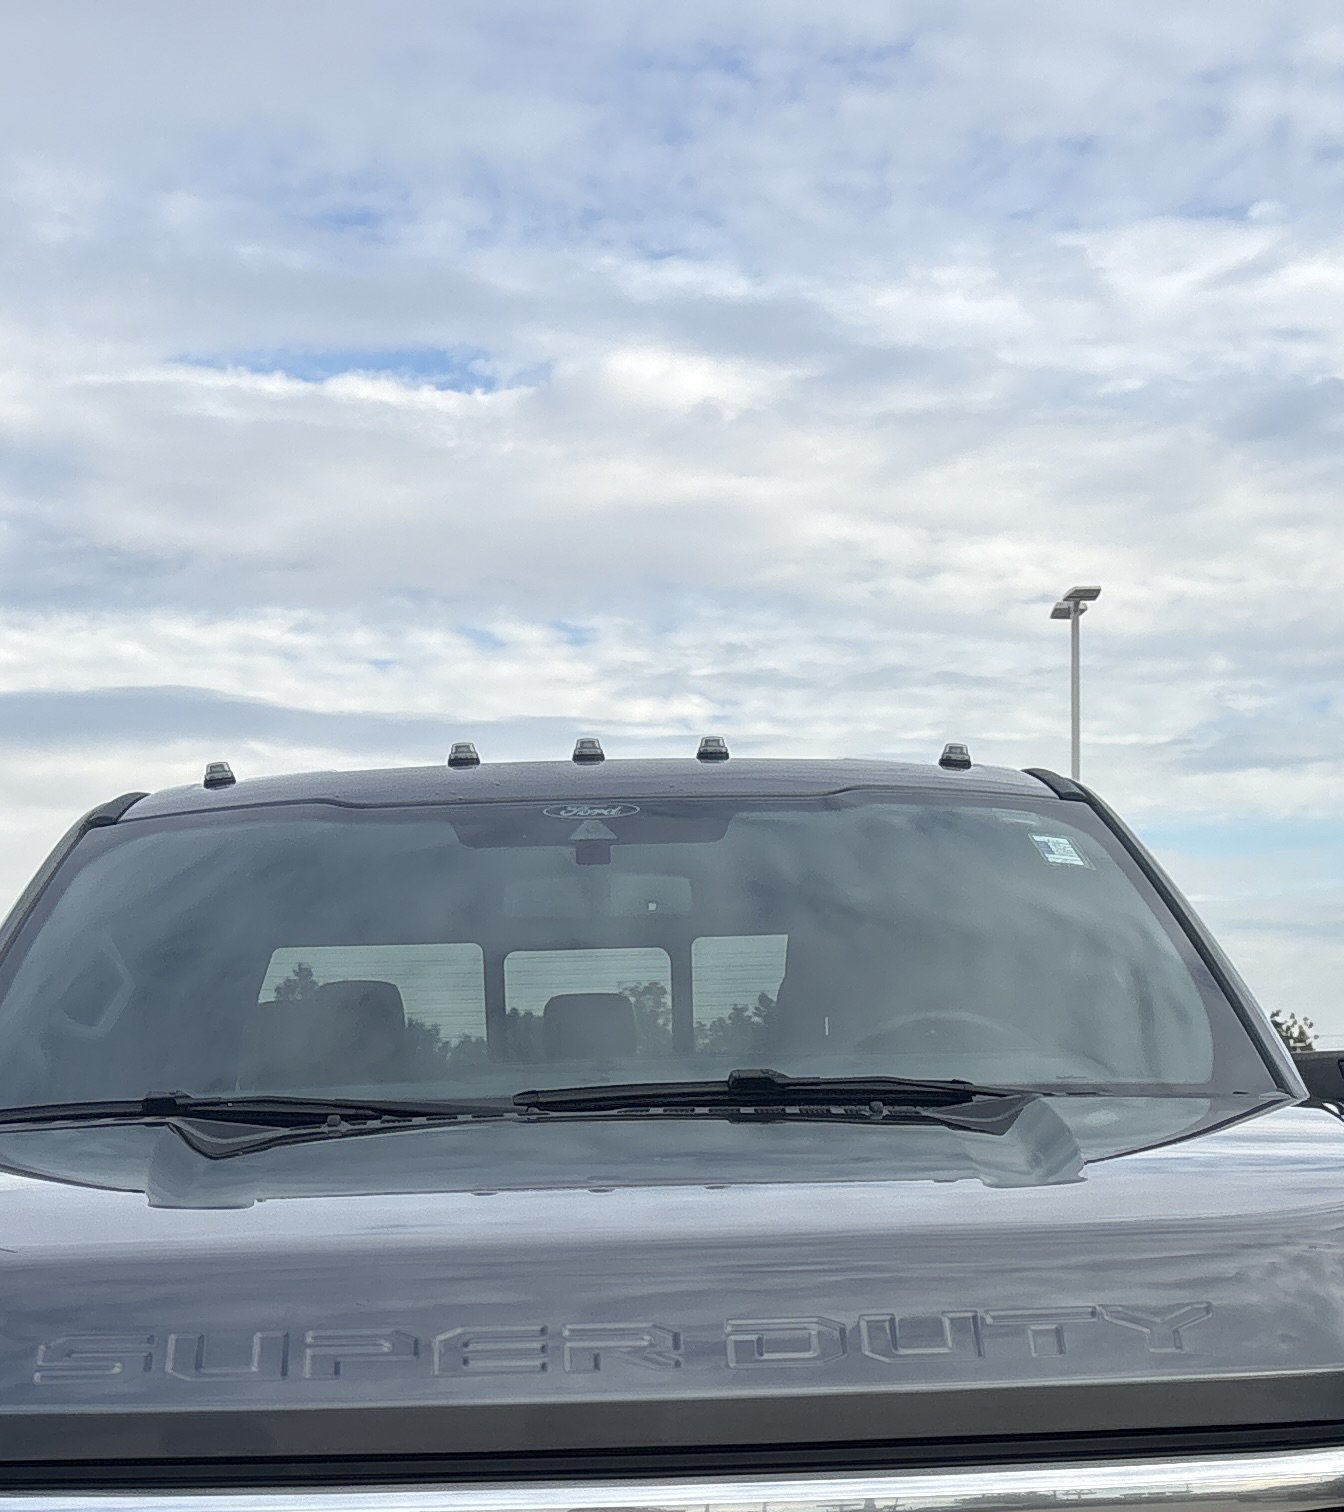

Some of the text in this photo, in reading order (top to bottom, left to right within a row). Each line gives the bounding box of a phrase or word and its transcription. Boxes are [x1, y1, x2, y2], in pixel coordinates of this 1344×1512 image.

[559, 805, 622, 817] Ford
[33, 1301, 1213, 1385] SUPER DUTY
